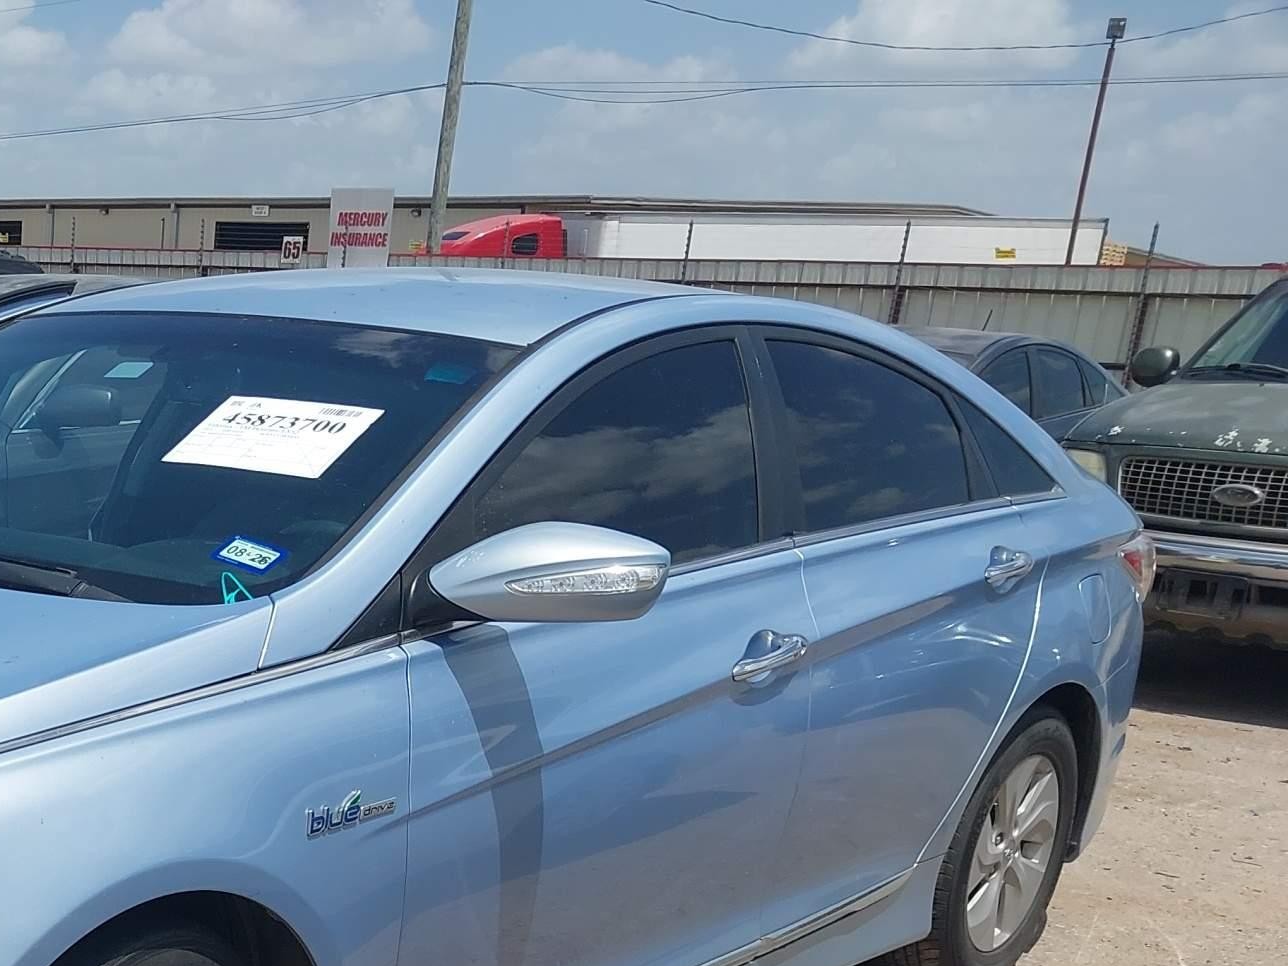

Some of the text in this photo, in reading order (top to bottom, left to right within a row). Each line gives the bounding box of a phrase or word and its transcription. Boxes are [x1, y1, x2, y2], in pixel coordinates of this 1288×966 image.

[337, 212, 388, 226] MERCURY
[330, 232, 388, 247] INSURANCE
[283, 241, 301, 259] 65
[222, 411, 347, 435] 45873700
[306, 801, 395, 837] blue drive
